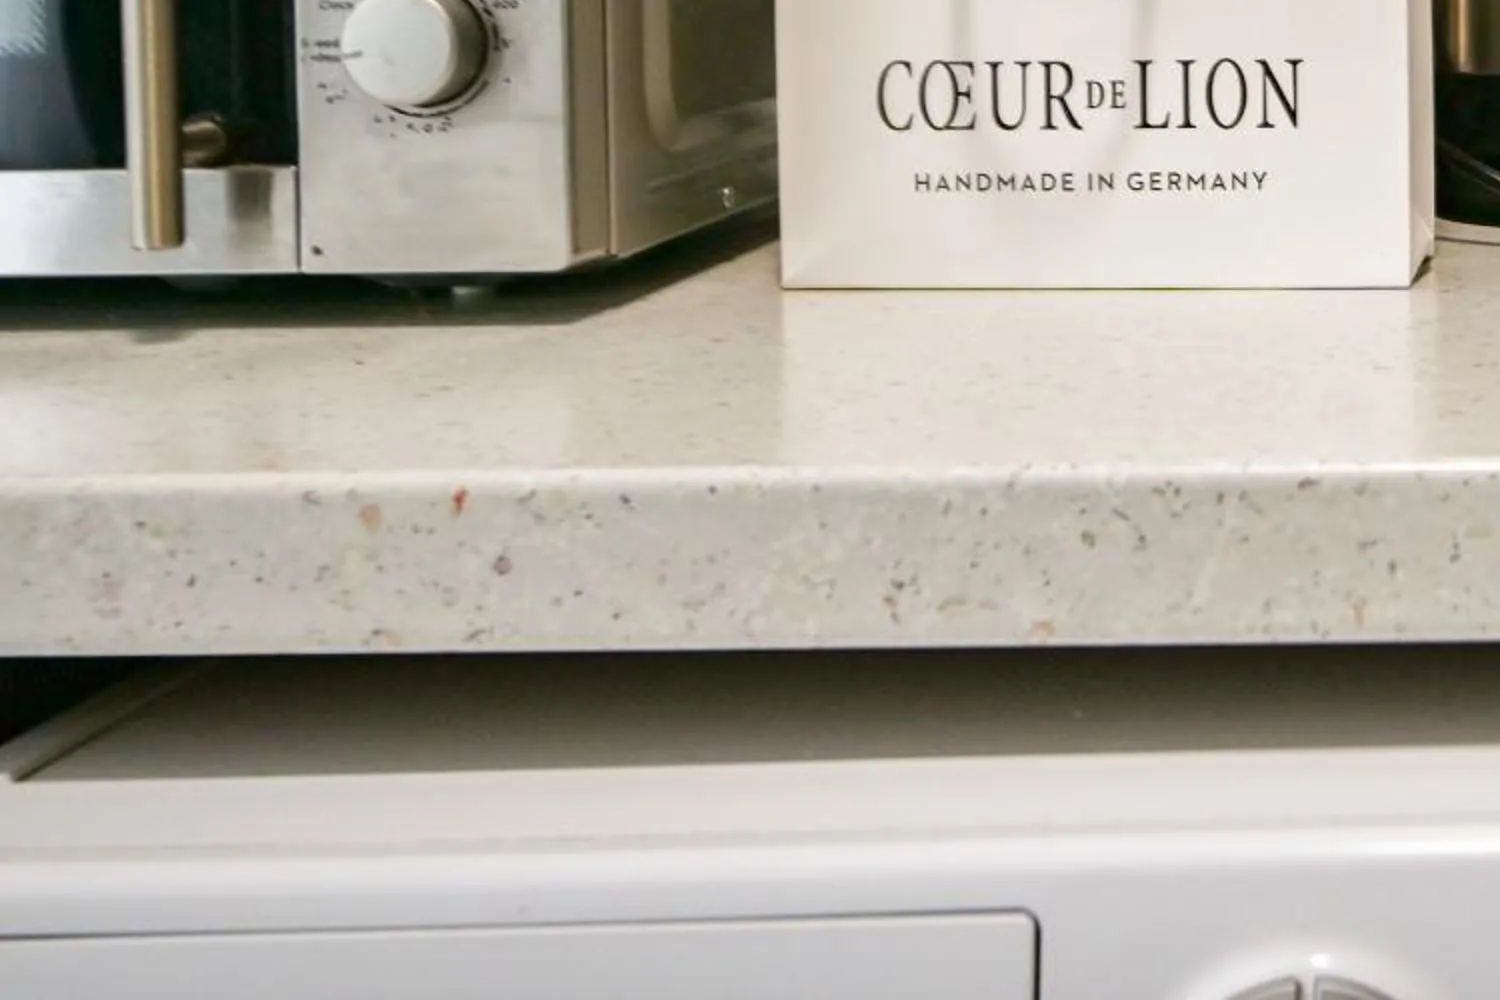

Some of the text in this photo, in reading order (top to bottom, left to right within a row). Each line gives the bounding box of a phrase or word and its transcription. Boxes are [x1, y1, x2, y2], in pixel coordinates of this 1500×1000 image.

[876, 57, 1305, 131] CŒUR DE LION
[913, 170, 1268, 192] HANDMADE IN GERMANY
